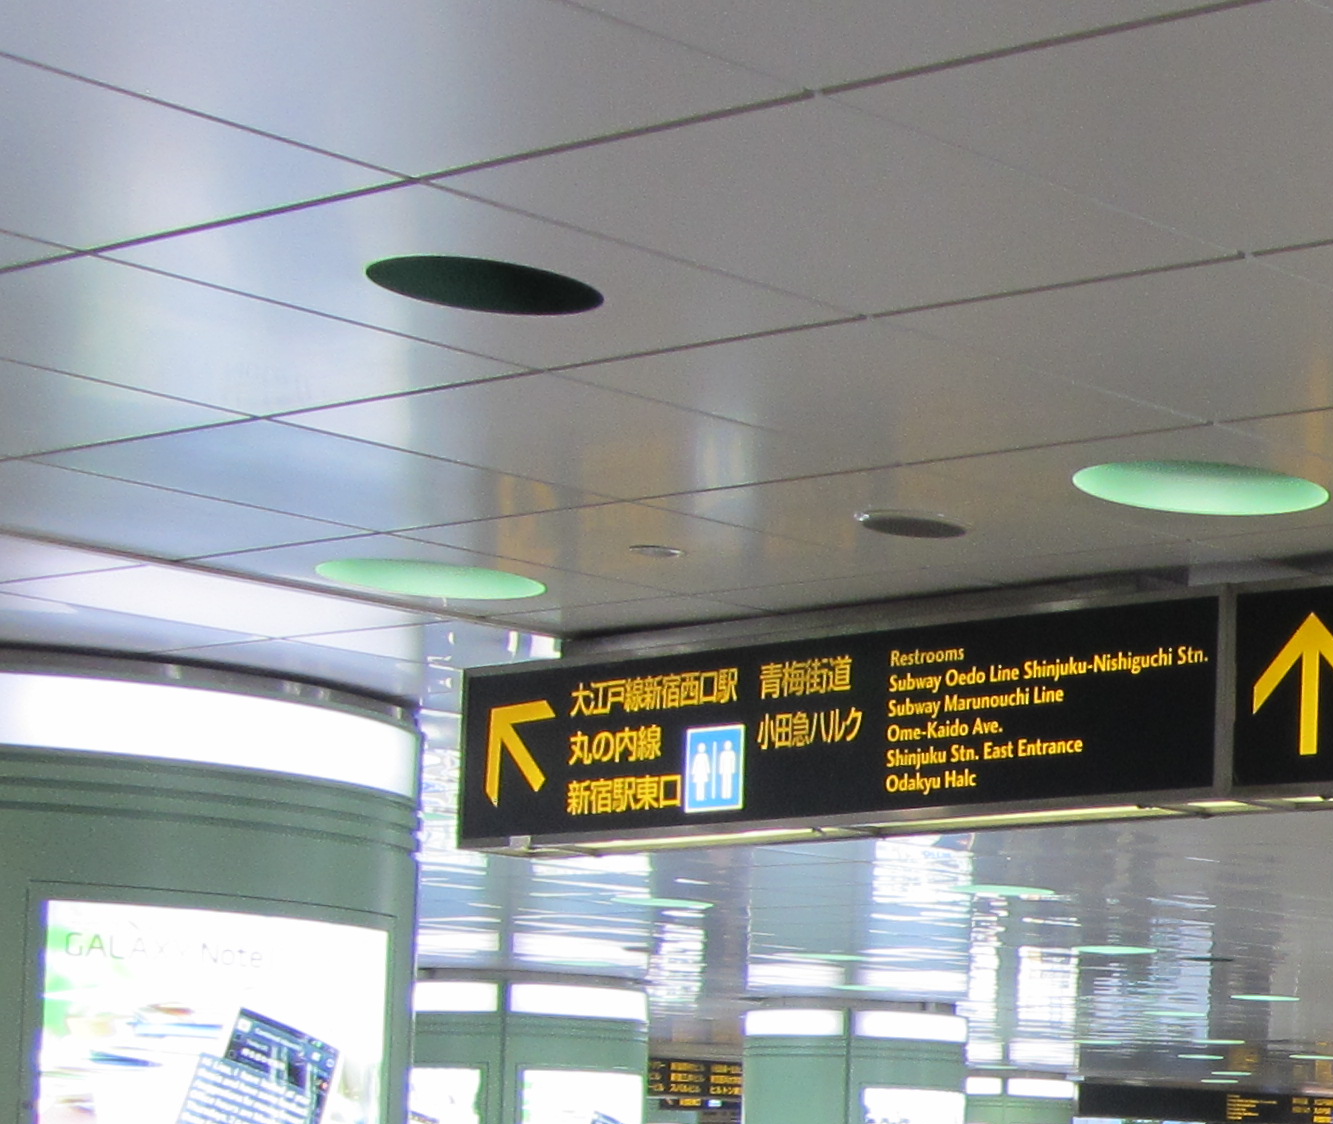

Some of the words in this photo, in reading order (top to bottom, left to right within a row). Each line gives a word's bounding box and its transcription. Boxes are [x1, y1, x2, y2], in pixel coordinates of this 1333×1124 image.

[889, 674, 943, 692] Subway
[945, 668, 986, 687] Oedo
[989, 667, 1020, 682] Line
[1023, 649, 1172, 680] Shinjuku-Nishiguchi
[1177, 646, 1207, 664] Stn.
[890, 648, 964, 666] Restrooms
[570, 668, 738, 715] 大江戸線新宿西口駅
[760, 656, 852, 697] 青梅街道
[888, 699, 943, 717] Subway
[944, 688, 1030, 712] Marunouchi
[1033, 687, 1064, 704] Line
[568, 725, 662, 764] 丸の内線
[757, 708, 863, 749] 小田急ハルク
[887, 720, 969, 742] Ome-Kaido
[972, 718, 1003, 734] Ave.
[886, 747, 947, 768] Shinjuku
[950, 744, 979, 762] Stn.
[983, 741, 1015, 760] East
[1017, 738, 1083, 757] Entrance
[566, 774, 682, 814] 新宿駅東口
[887, 775, 941, 793] Odakyu
[945, 771, 976, 787] Halc
[64, 931, 187, 960] GALAXY
[201, 941, 264, 969] Note
